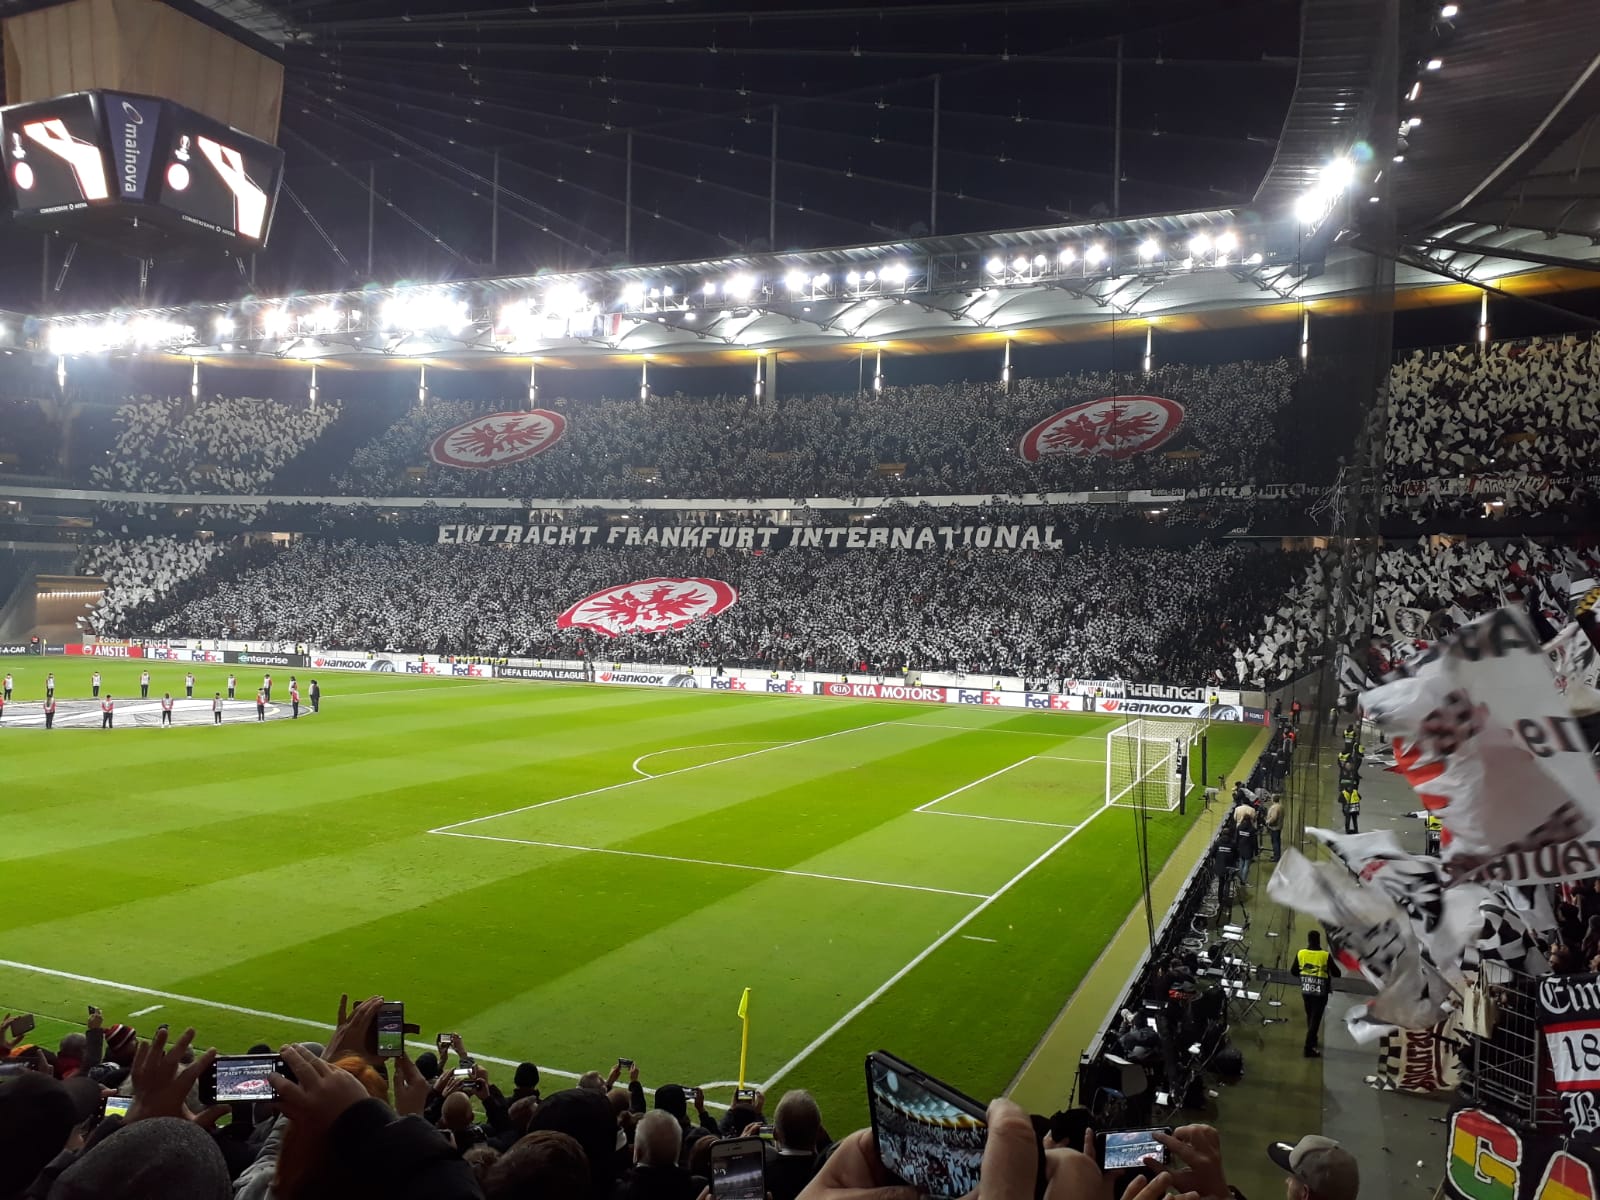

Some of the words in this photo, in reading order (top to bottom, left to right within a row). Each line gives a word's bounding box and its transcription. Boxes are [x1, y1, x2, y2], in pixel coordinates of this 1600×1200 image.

[125, 123, 140, 192] mainova
[438, 524, 599, 545] EINTRACHT
[606, 526, 779, 548] FRANKFURT
[789, 525, 1063, 550] INTERNATIONAL
[94, 646, 130, 657] AMSTEL
[154, 648, 178, 660] FedEx
[191, 650, 217, 662] FedEx
[238, 653, 289, 665] enterprise
[406, 660, 436, 675] FedEx
[452, 663, 483, 677] FedEx
[501, 668, 522, 677] UEFA
[523, 669, 553, 679] EUROPA
[554, 671, 586, 680] LEAGUE
[710, 676, 746, 691] FedEx
[766, 678, 803, 694] FedEx
[853, 683, 876, 697] KIA
[880, 685, 942, 701] MOTORS
[958, 689, 1001, 705] FedEx
[1025, 693, 1070, 710] FedEx
